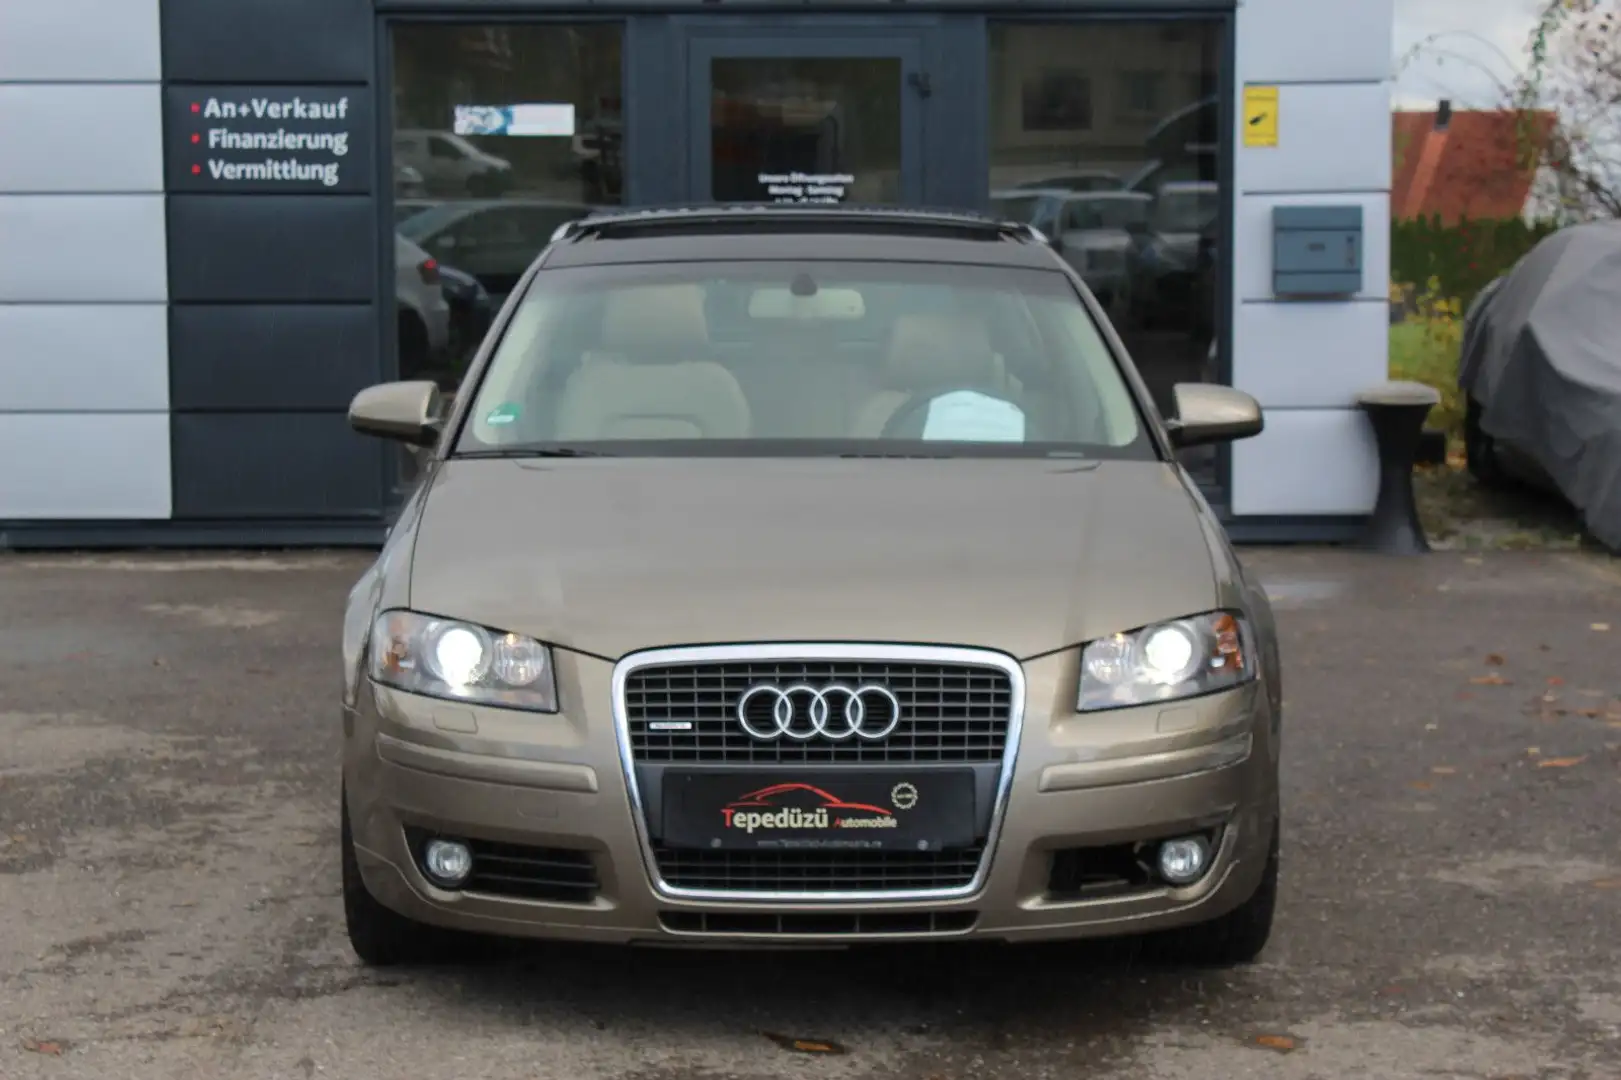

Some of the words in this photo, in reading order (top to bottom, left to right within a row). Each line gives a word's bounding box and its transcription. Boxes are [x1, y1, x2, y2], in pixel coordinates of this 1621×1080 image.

[203, 96, 349, 119] An+Verkauf
[207, 127, 349, 156] Finanzierung
[207, 157, 340, 187] Vermittlung
[720, 807, 829, 833] Tepedüzü
[833, 816, 898, 829] Automobile
